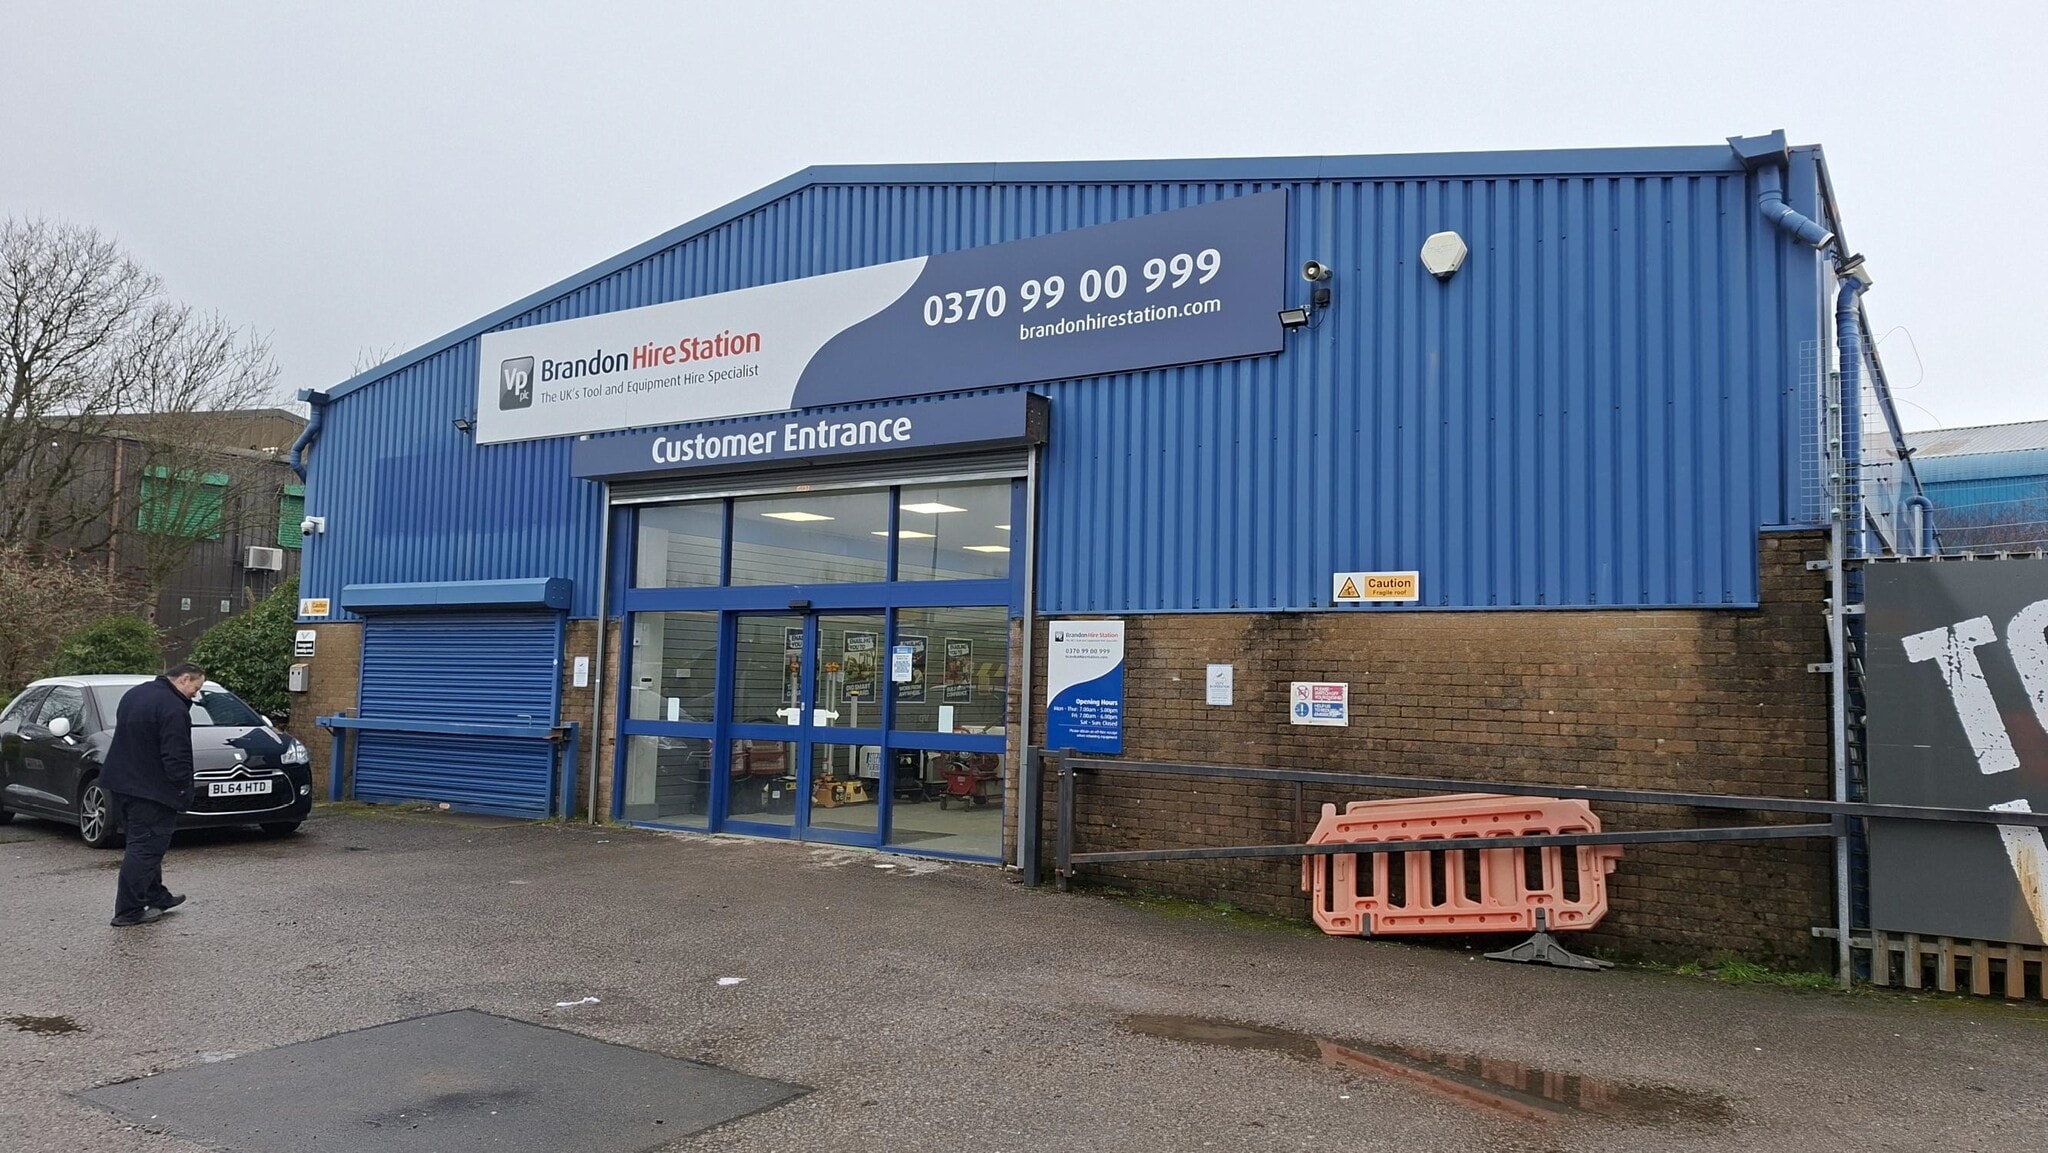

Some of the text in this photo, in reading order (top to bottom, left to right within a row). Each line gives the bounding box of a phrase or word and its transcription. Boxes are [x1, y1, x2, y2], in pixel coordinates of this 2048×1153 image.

[924, 248, 1221, 326] 0370 99 00 999
[1020, 298, 1221, 341] brandonhirestation.com
[541, 349, 629, 382] Brandon
[503, 367, 528, 396] Vp
[519, 390, 529, 402] plc
[541, 363, 759, 404] The UK's Tool and Equipment Hire Specialist
[652, 417, 912, 464] Customer Entrance
[1368, 578, 1411, 588] Caution
[1373, 589, 1393, 597] Fragile
[1075, 698, 1100, 707] Opening
[213, 781, 266, 794] BL64 HTD
